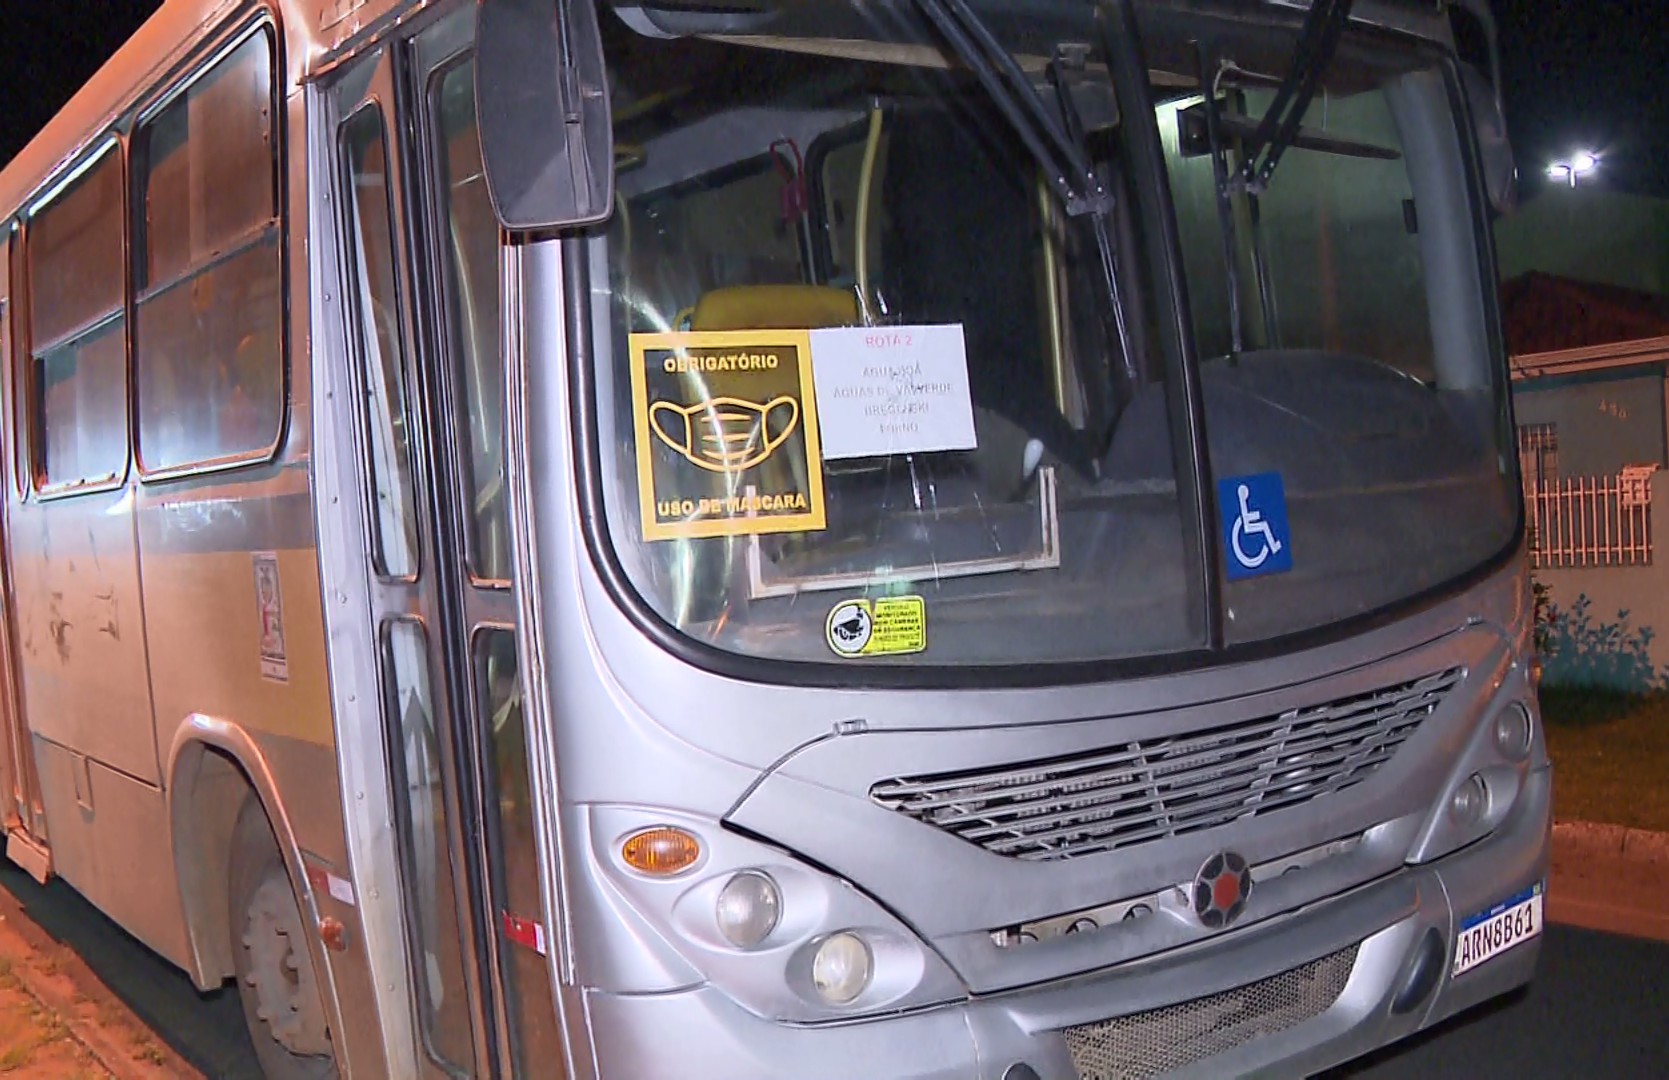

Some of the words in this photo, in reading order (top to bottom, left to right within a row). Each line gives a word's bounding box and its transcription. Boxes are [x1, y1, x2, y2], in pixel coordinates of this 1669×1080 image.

[866, 335, 900, 347] ROTA
[905, 335, 913, 346] 2
[663, 353, 778, 373] OBRIGATÓRIO
[658, 501, 694, 516] USO
[700, 499, 721, 513] DE
[1461, 902, 1533, 967] ARN8B61
